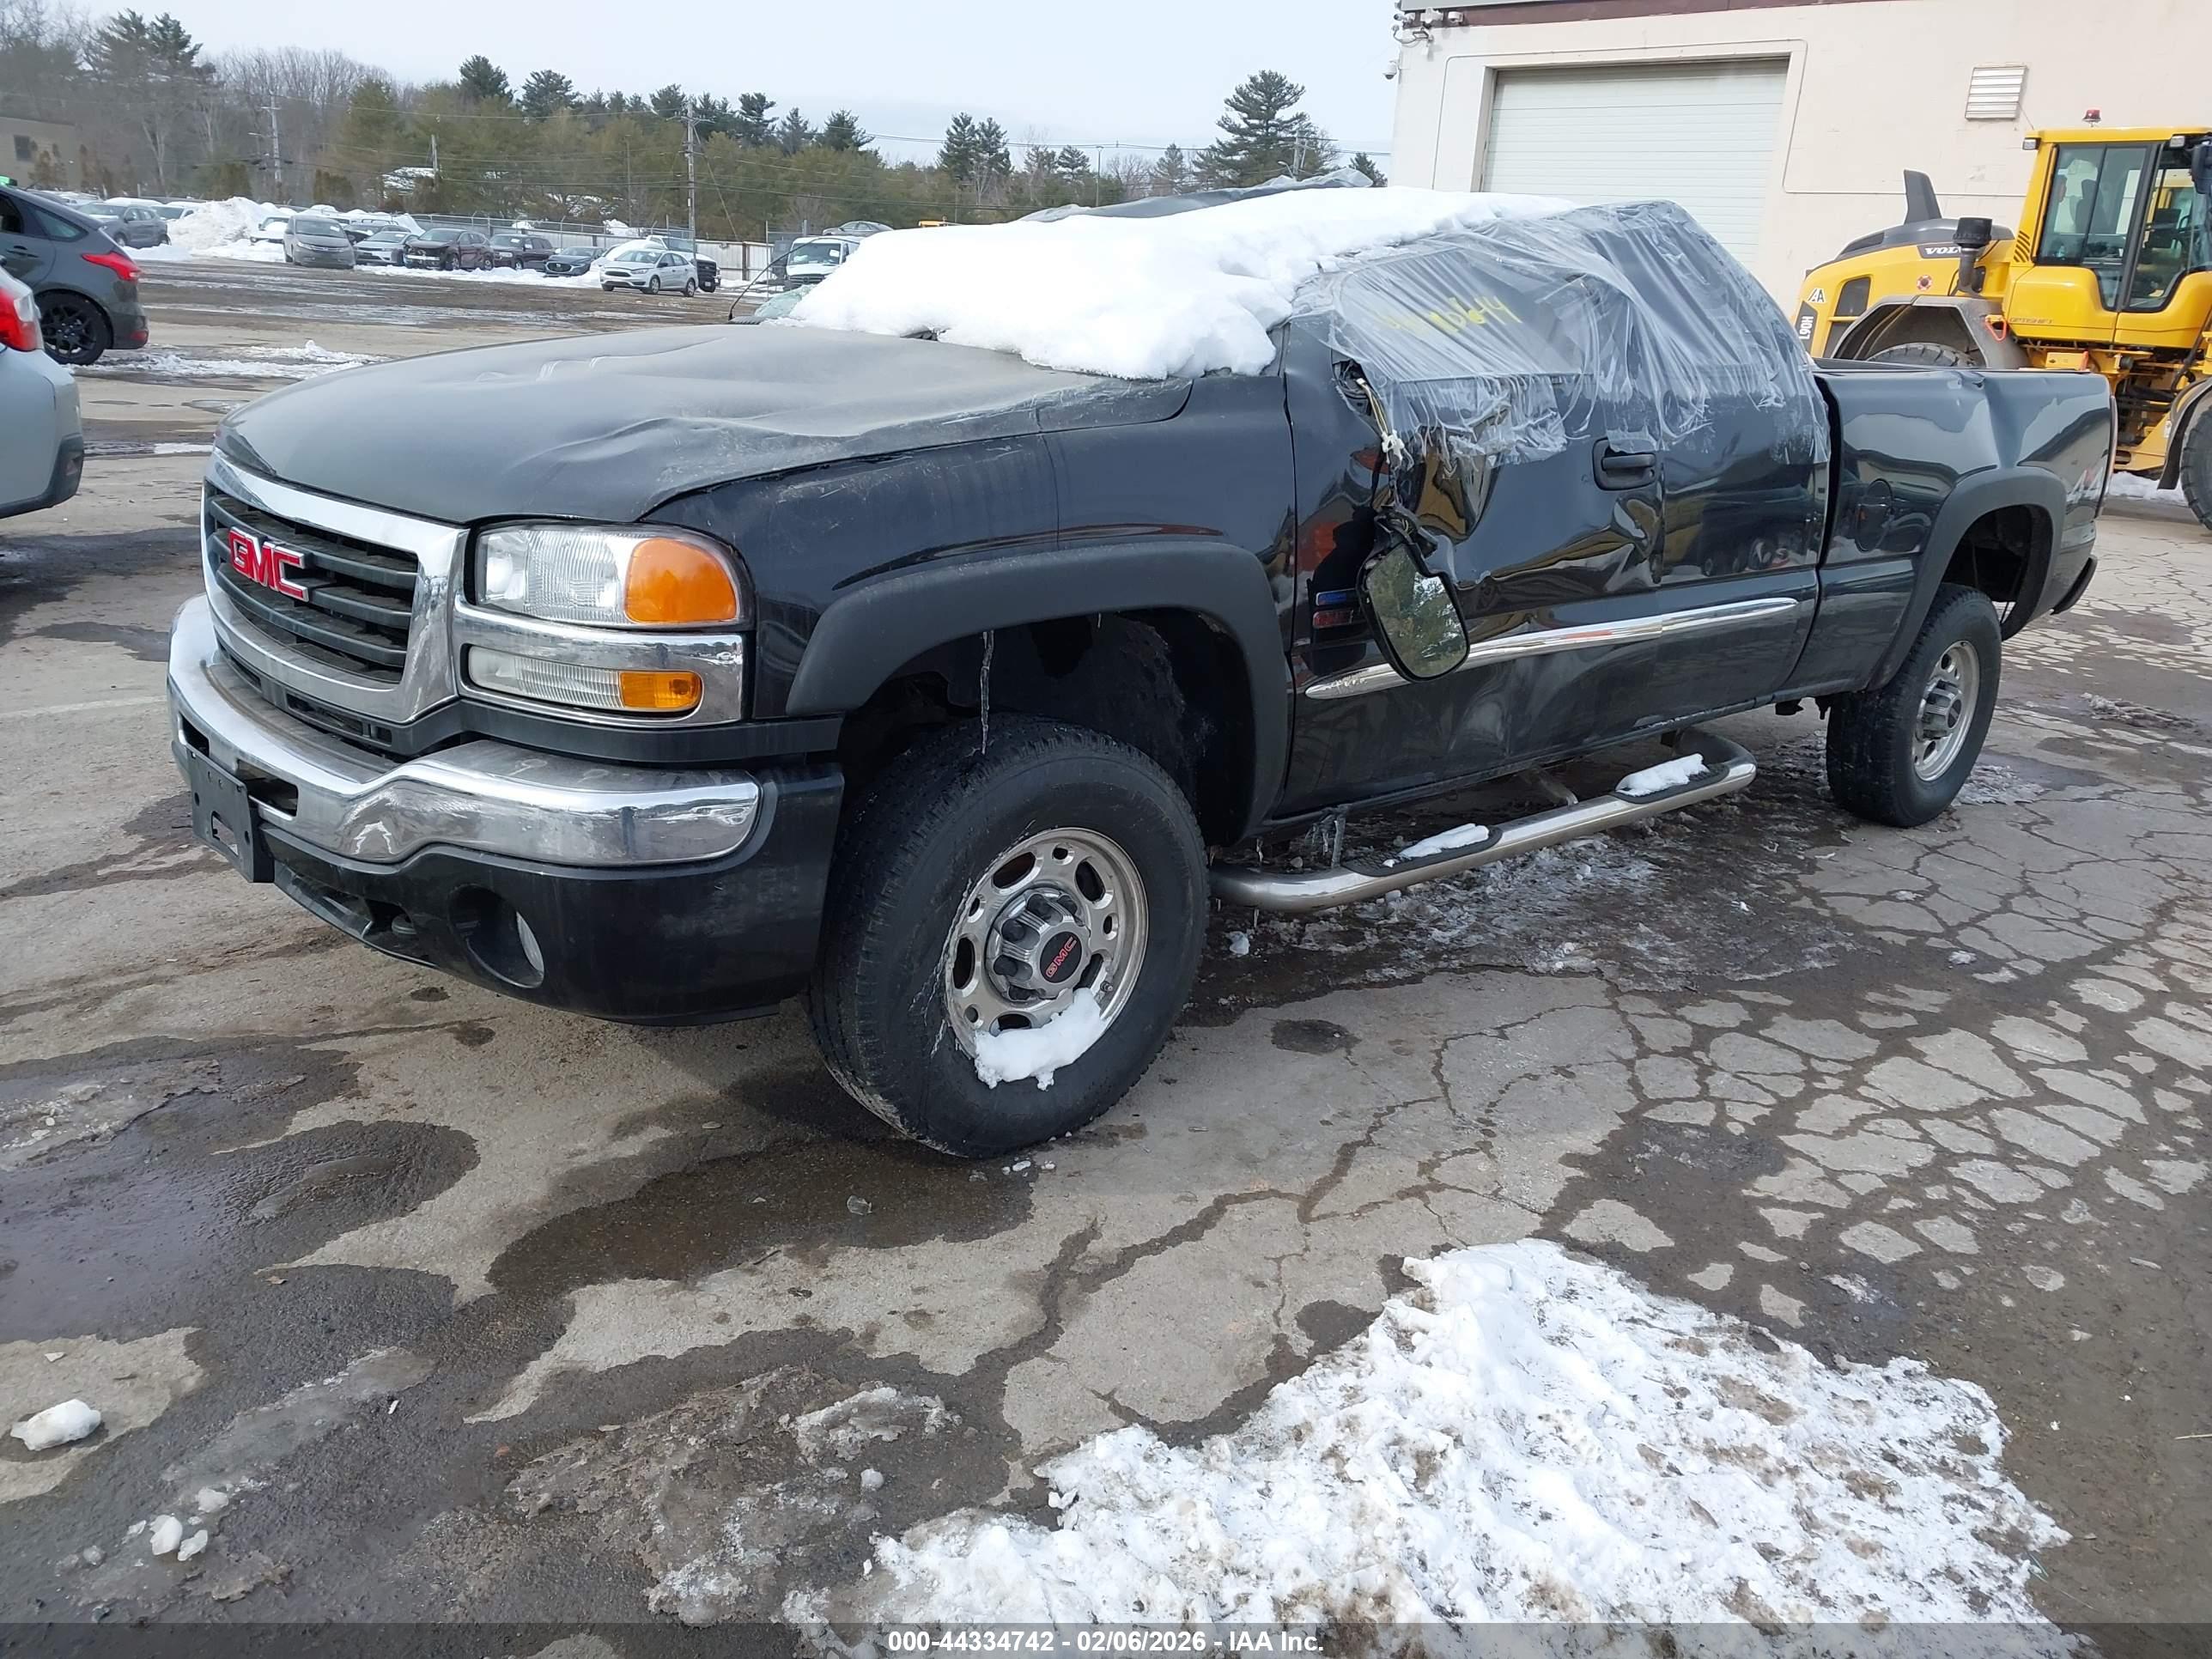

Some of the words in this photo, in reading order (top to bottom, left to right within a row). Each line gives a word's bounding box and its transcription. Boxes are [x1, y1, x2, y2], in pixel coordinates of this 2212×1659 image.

[1924, 246, 1961, 255] VOL
[1798, 316, 1814, 340] L90H
[228, 525, 310, 603] GMC
[1044, 936, 1078, 979] GMC
